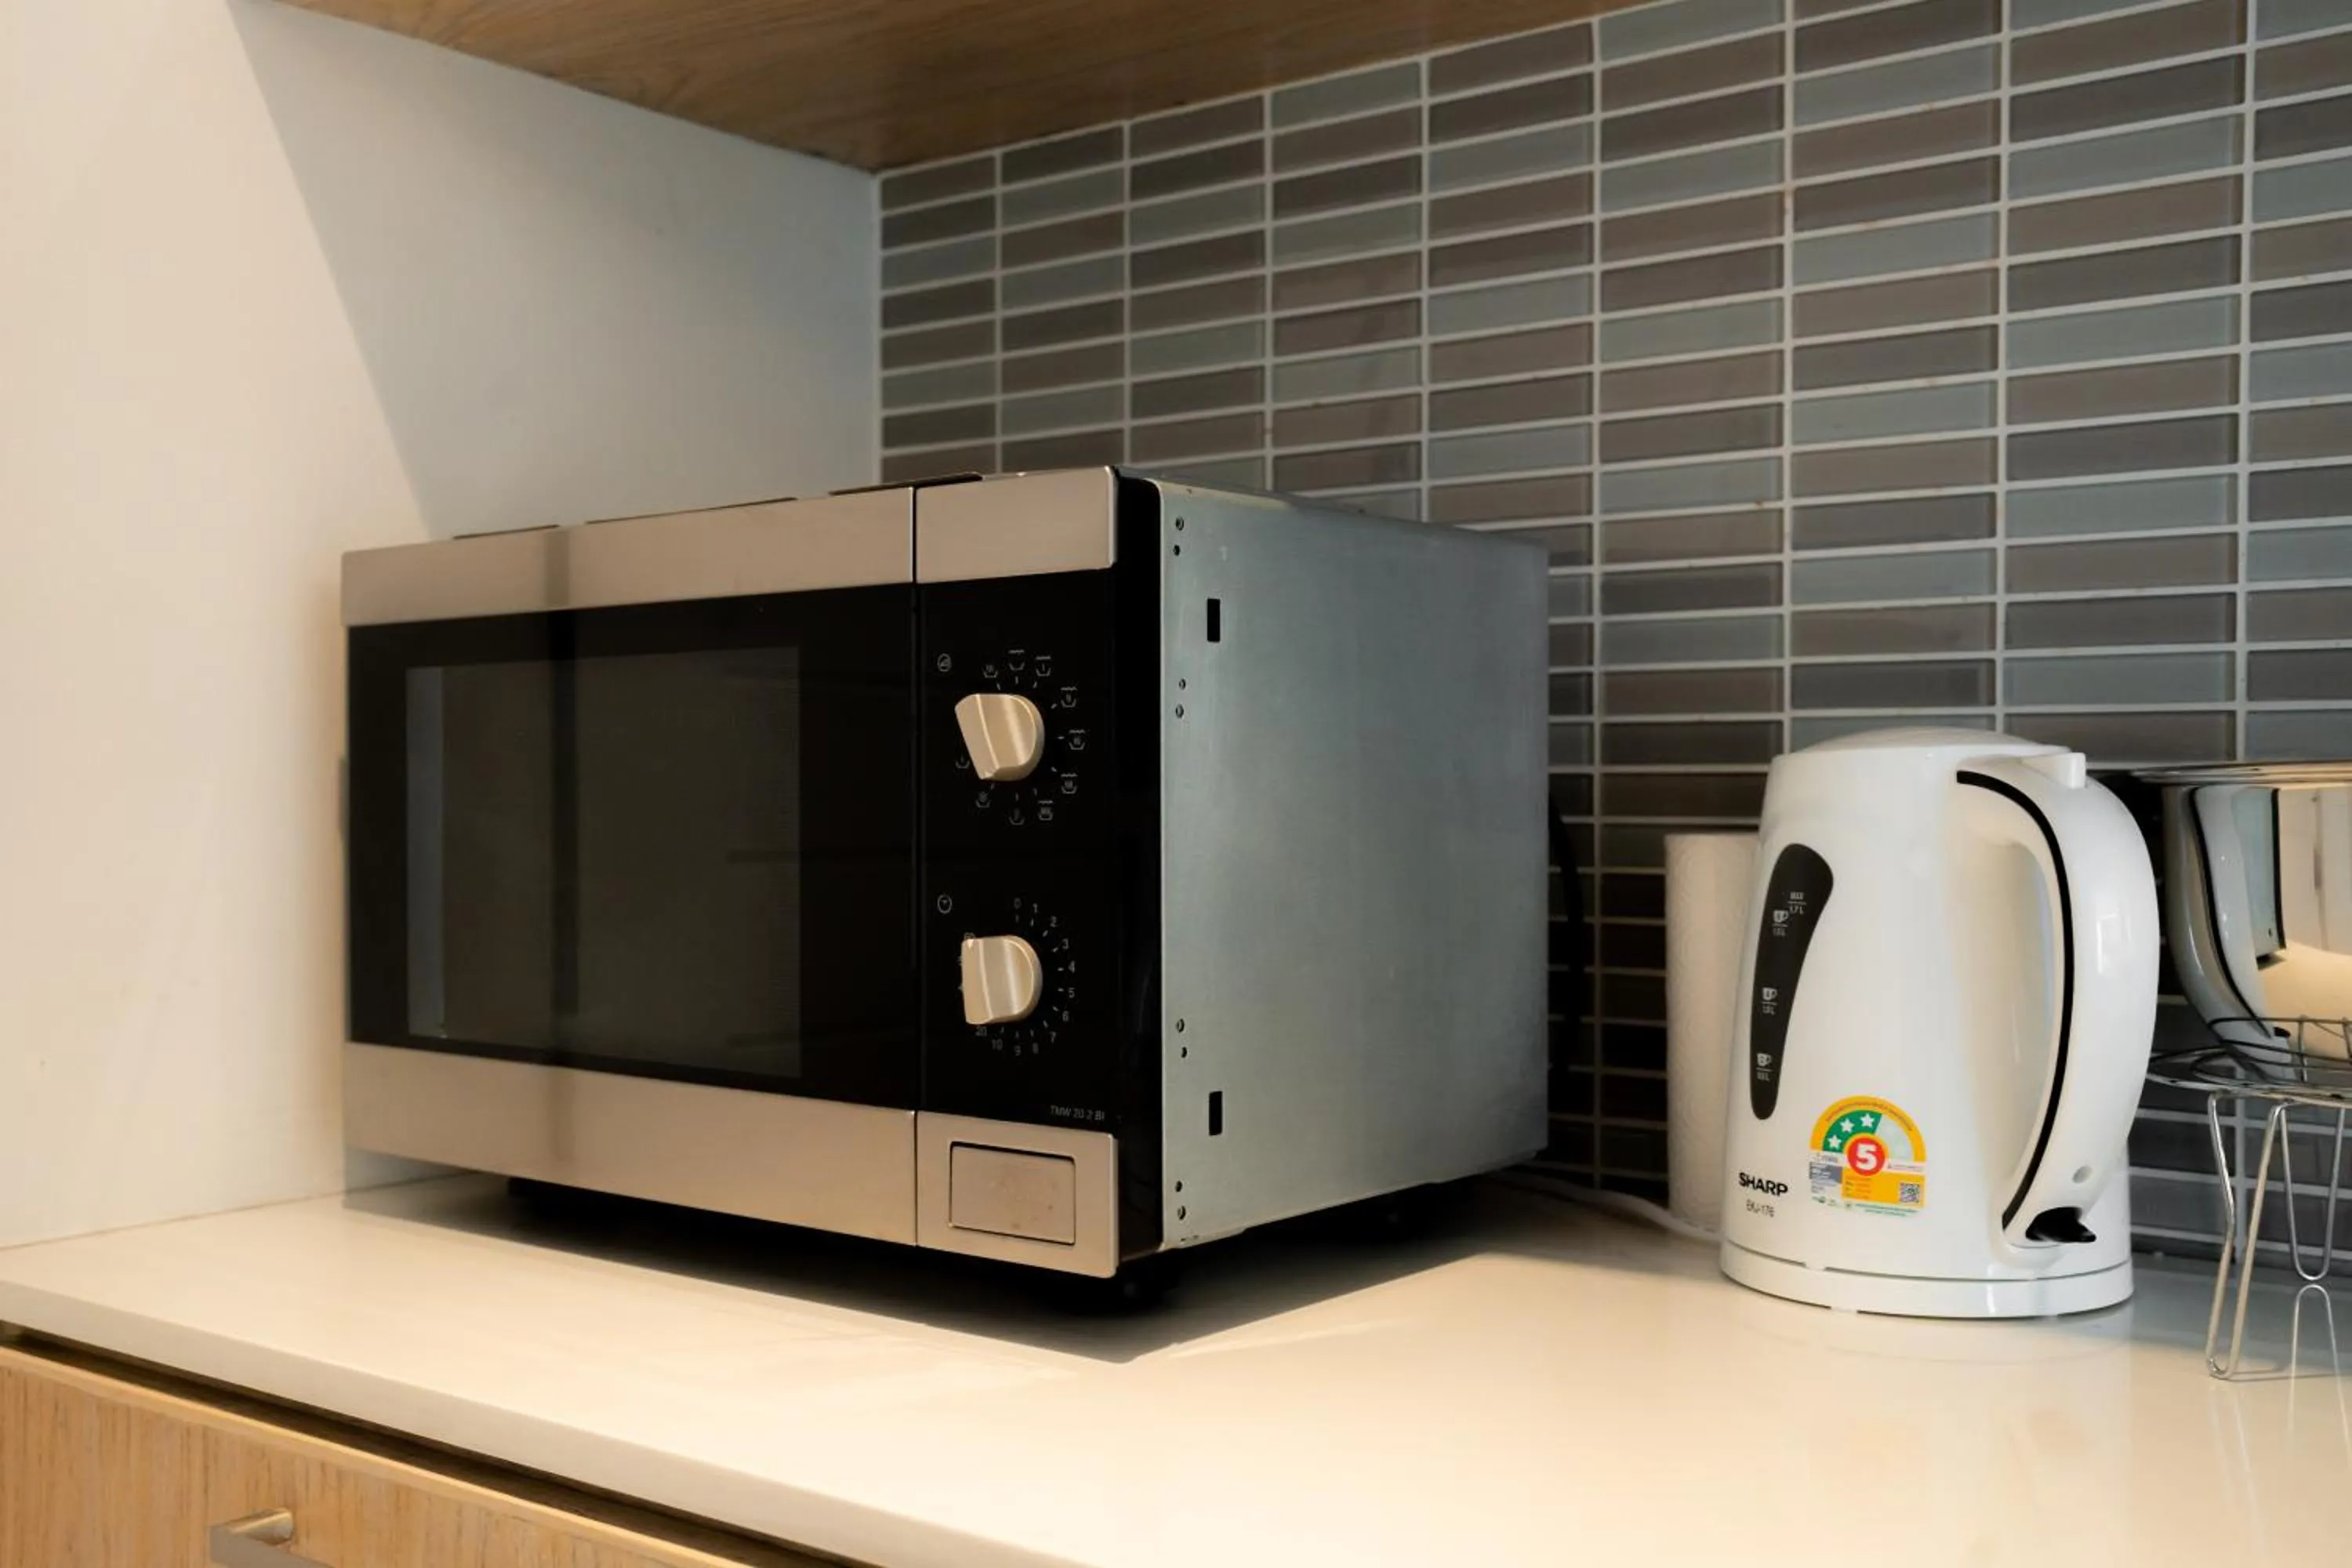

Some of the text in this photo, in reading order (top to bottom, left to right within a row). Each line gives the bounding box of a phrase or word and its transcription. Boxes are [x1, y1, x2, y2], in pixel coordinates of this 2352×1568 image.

[1032, 903, 1038, 913] 1
[1050, 916, 1058, 927] 2
[1062, 938, 1069, 949] 3
[1068, 960, 1076, 973] 4
[1068, 987, 1075, 999] 5
[1062, 1011, 1069, 1022] 6
[1049, 1032, 1057, 1044] 7
[992, 1039, 1004, 1051] 10
[1855, 1144, 1878, 1171] 5
[1738, 1172, 1788, 1196] SHARP
